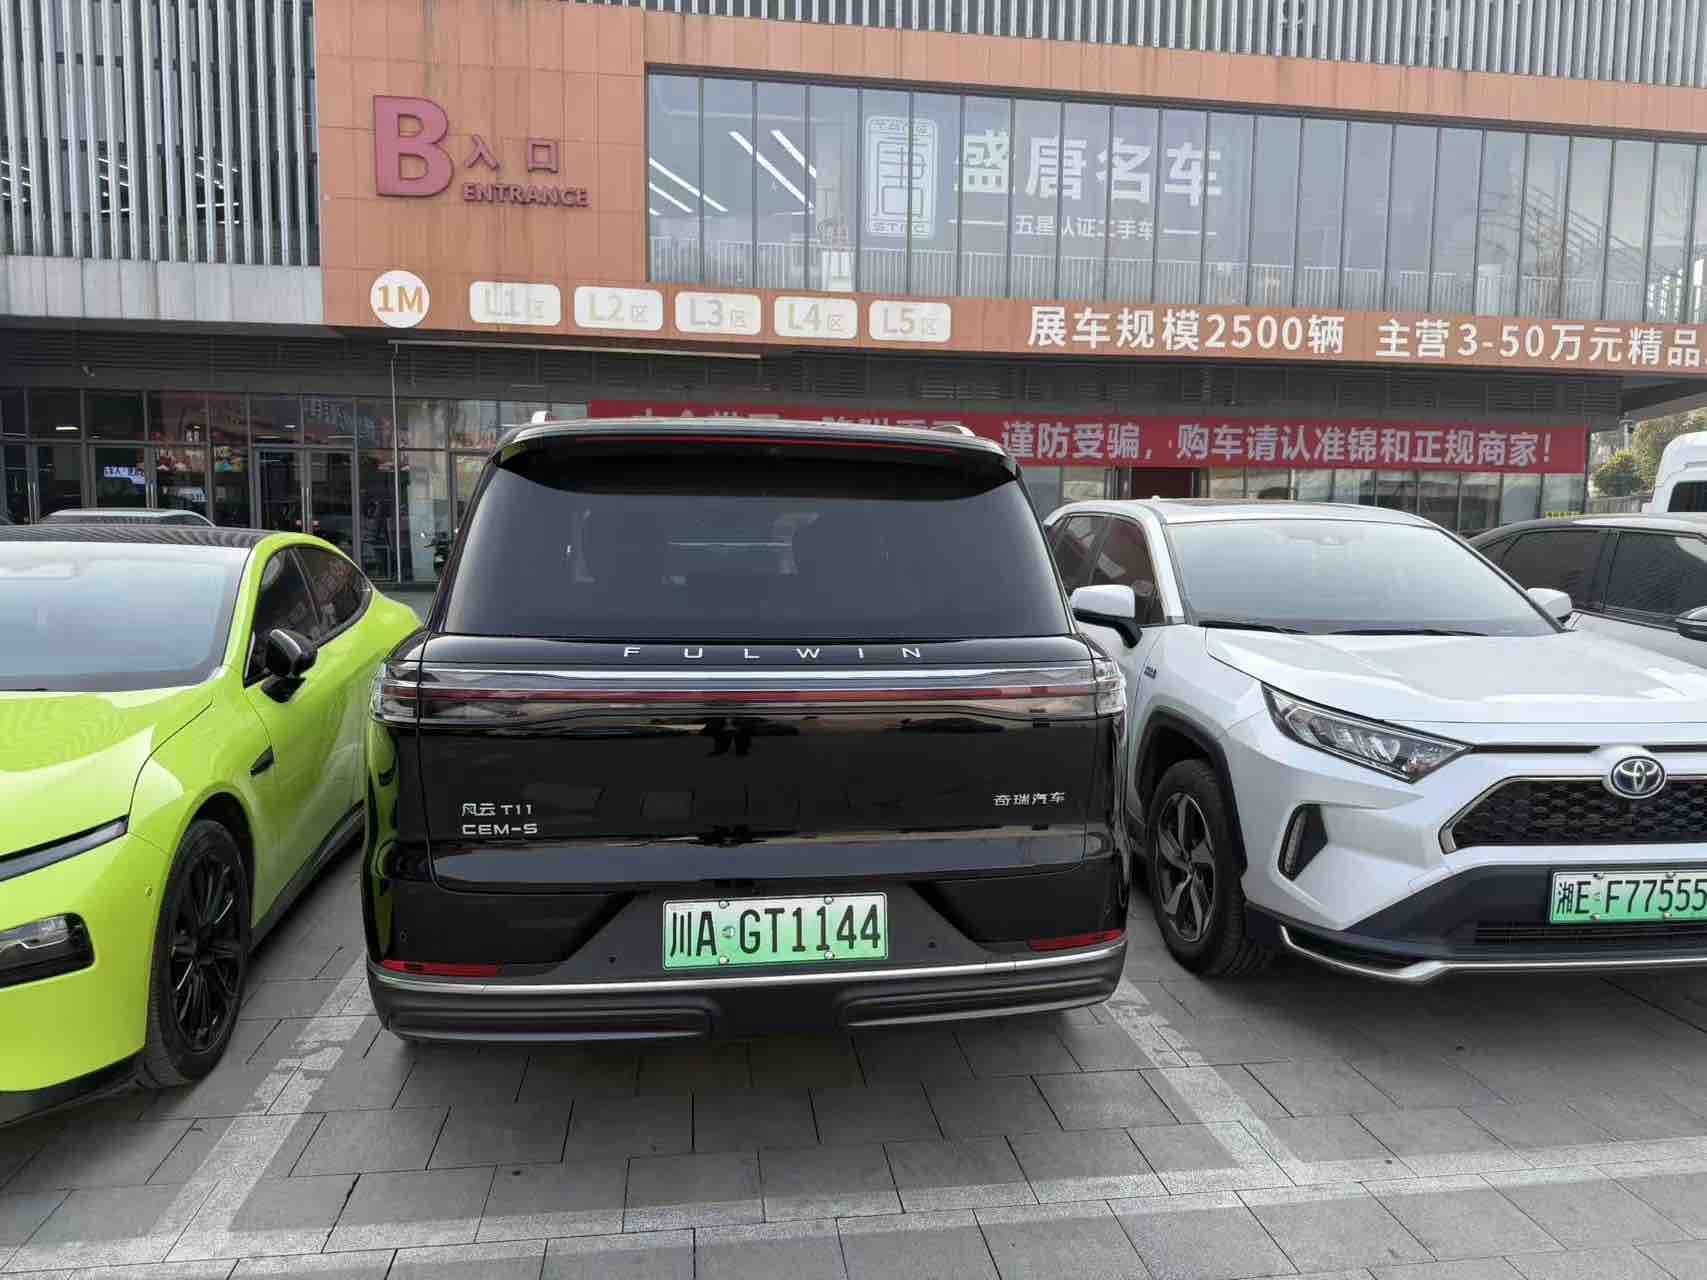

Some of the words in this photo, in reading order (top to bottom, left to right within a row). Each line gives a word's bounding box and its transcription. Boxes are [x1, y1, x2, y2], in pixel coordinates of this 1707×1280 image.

[374, 95, 455, 198] B
[464, 134, 560, 173] 入口
[954, 128, 1222, 206] 盛唐名车
[463, 182, 590, 208] ENTRANCE
[377, 285, 424, 313] 1M
[1028, 305, 1345, 354] 展车规模2500辆
[1375, 318, 1707, 367] 主营3-50万元精品
[623, 646, 921, 660] FULWIN
[461, 802, 496, 817] 风云
[499, 803, 533, 816] T11
[992, 791, 1065, 807] 奇瑞汽车
[461, 822, 538, 835] CEM-S
